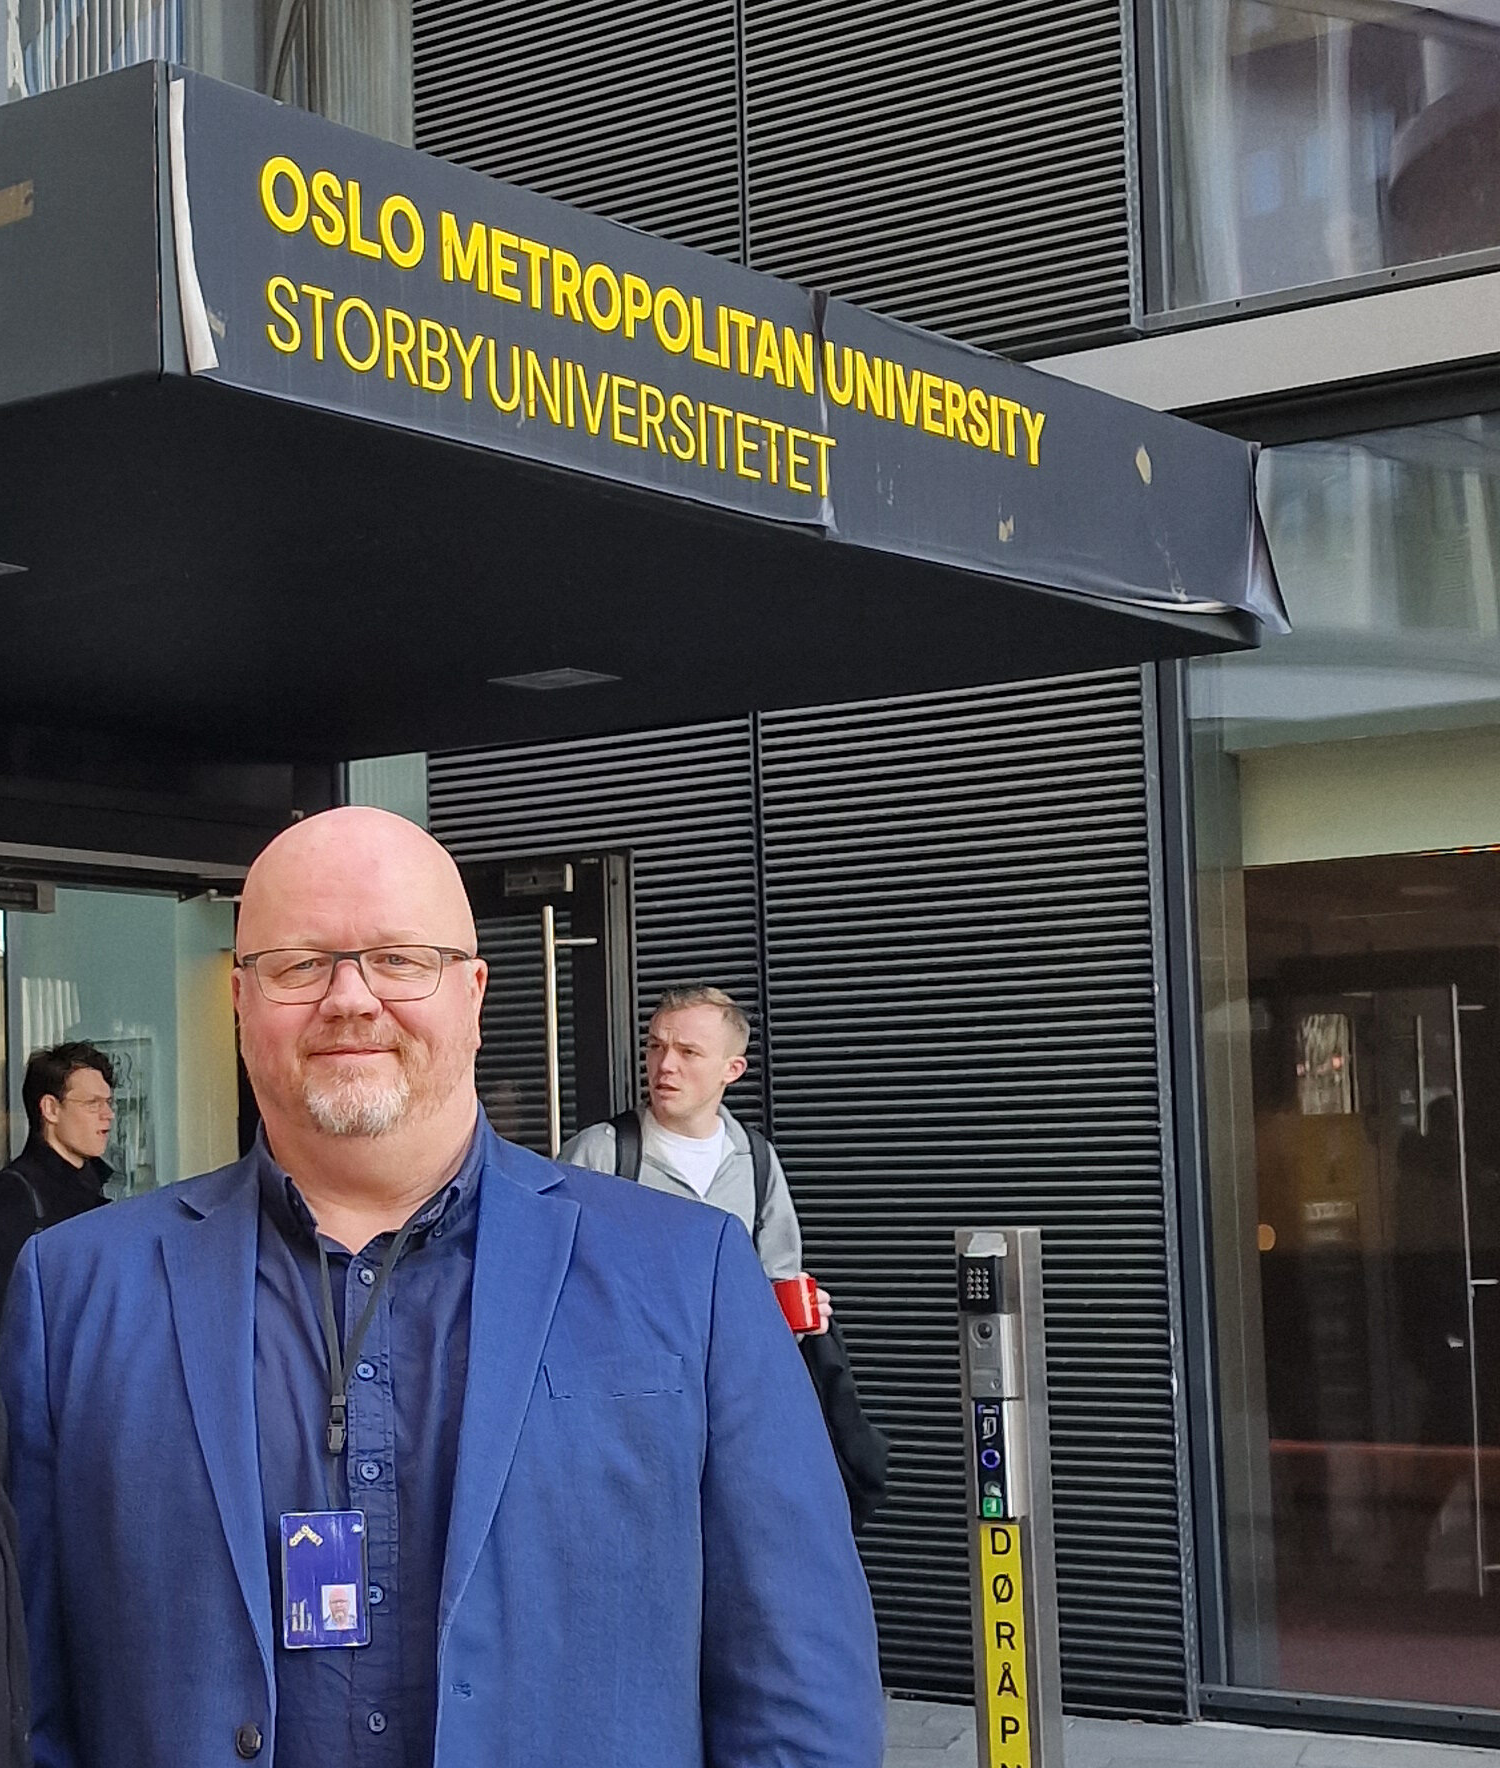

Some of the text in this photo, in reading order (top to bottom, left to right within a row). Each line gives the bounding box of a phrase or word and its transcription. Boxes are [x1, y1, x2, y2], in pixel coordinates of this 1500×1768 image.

[257, 156, 1046, 467] OSLO METROPOLITAN UNIVERSITY
[265, 275, 837, 498] STORBYUNIVERSITETET
[990, 1527, 1022, 1768] DØRÅP
